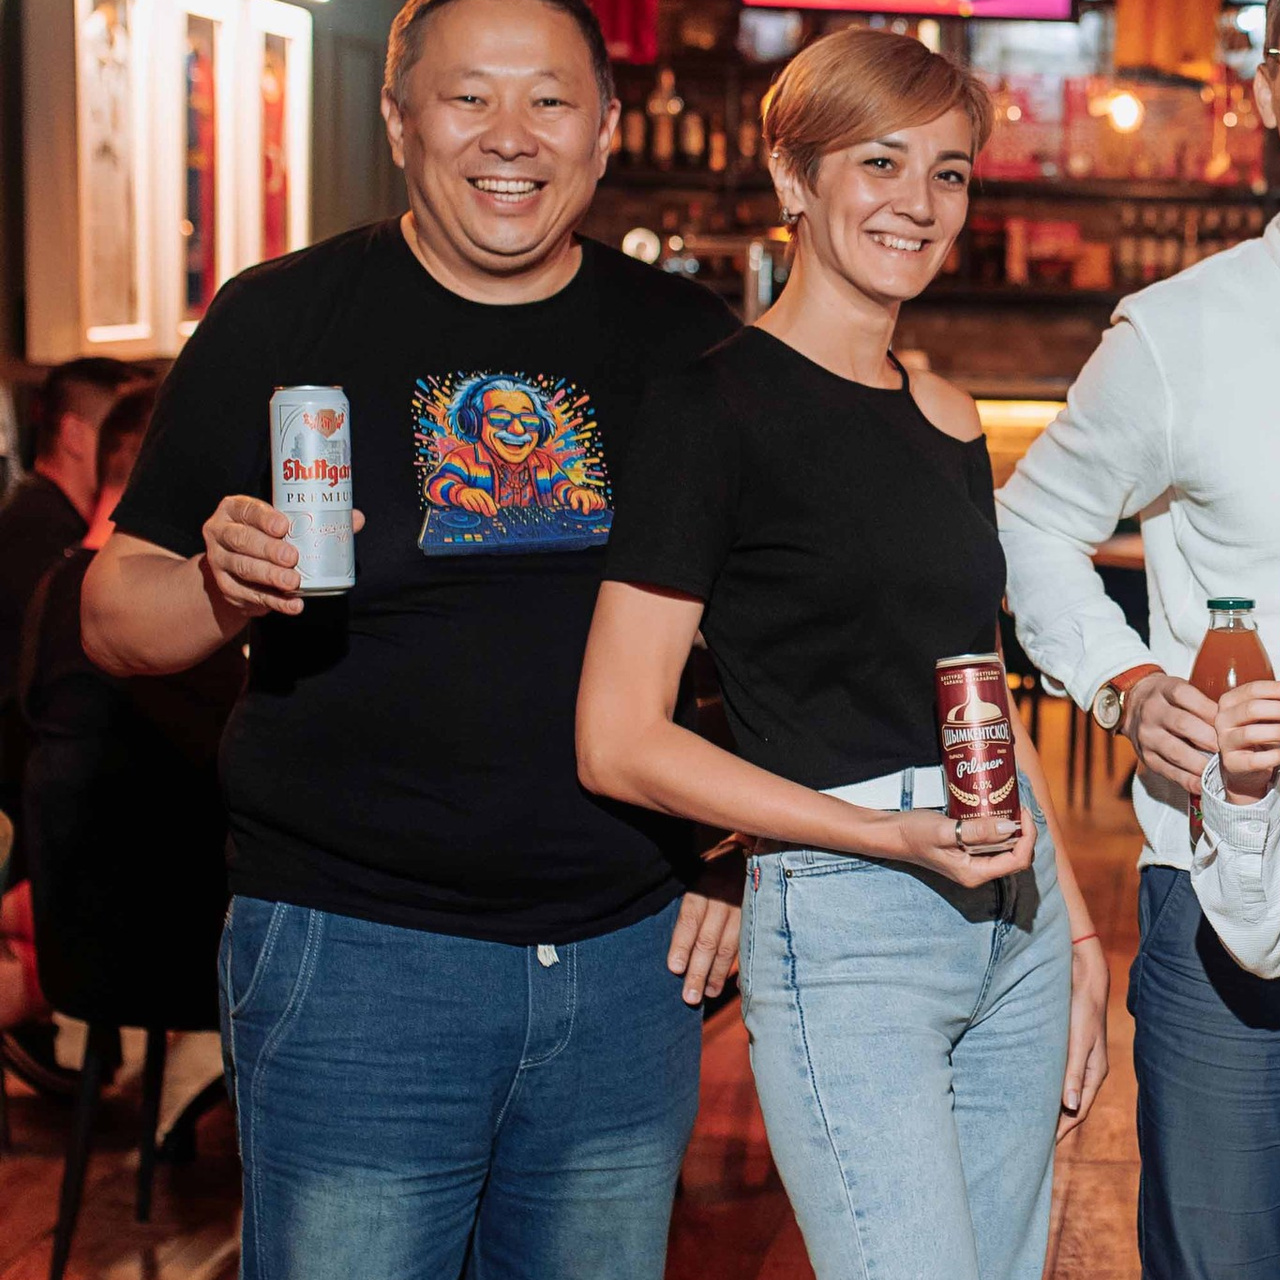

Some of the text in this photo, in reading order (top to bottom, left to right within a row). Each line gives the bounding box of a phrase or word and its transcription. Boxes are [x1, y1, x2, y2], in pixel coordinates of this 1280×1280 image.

[283, 458, 351, 488] Stuttga
[287, 492, 352, 503] PREMIU
[944, 723, 1009, 746] ШЫМКЕНТСКОЕ
[957, 757, 1003, 778] Pilsner
